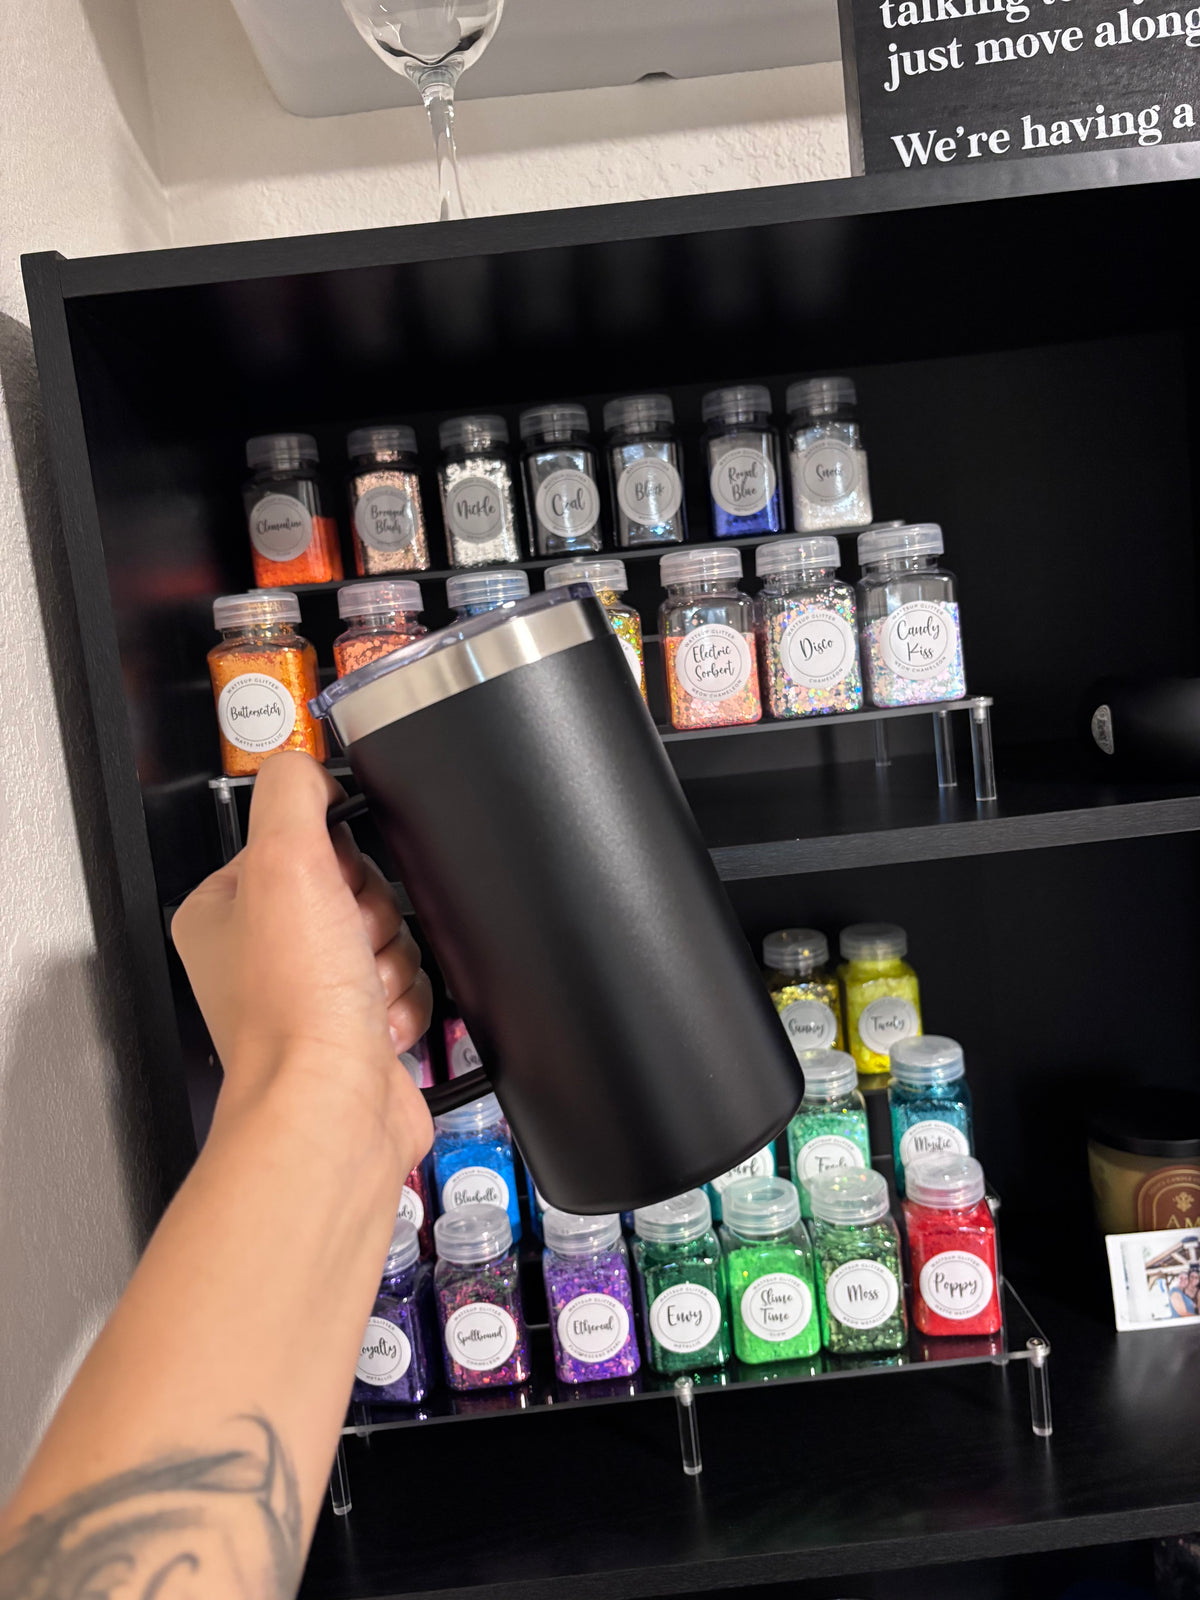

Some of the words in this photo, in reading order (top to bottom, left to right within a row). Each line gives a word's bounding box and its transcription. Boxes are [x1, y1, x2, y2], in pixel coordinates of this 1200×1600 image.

[884, 37, 965, 92] just
[975, 25, 1083, 65] move
[1094, 8, 1200, 47] along
[1021, 104, 1161, 146] having
[1172, 103, 1195, 130] a
[732, 481, 758, 502] Blue
[457, 495, 496, 519] Nickle
[897, 615, 940, 640] Candy
[692, 643, 731, 663] Electric
[799, 637, 833, 661] Disco
[907, 642, 935, 661] Kiss
[695, 660, 735, 682] Sorbert
[230, 702, 281, 721] Butterscotch
[913, 1135, 952, 1153] Mystic
[847, 1283, 880, 1303] Moss
[934, 1271, 977, 1298] Poppy
[761, 1287, 793, 1307] Slime
[573, 1315, 614, 1335] Ethereal
[667, 1304, 702, 1326] Envy
[760, 1307, 790, 1325] Time
[457, 1325, 503, 1347] Spellbound
[361, 1337, 397, 1359] oyalty
